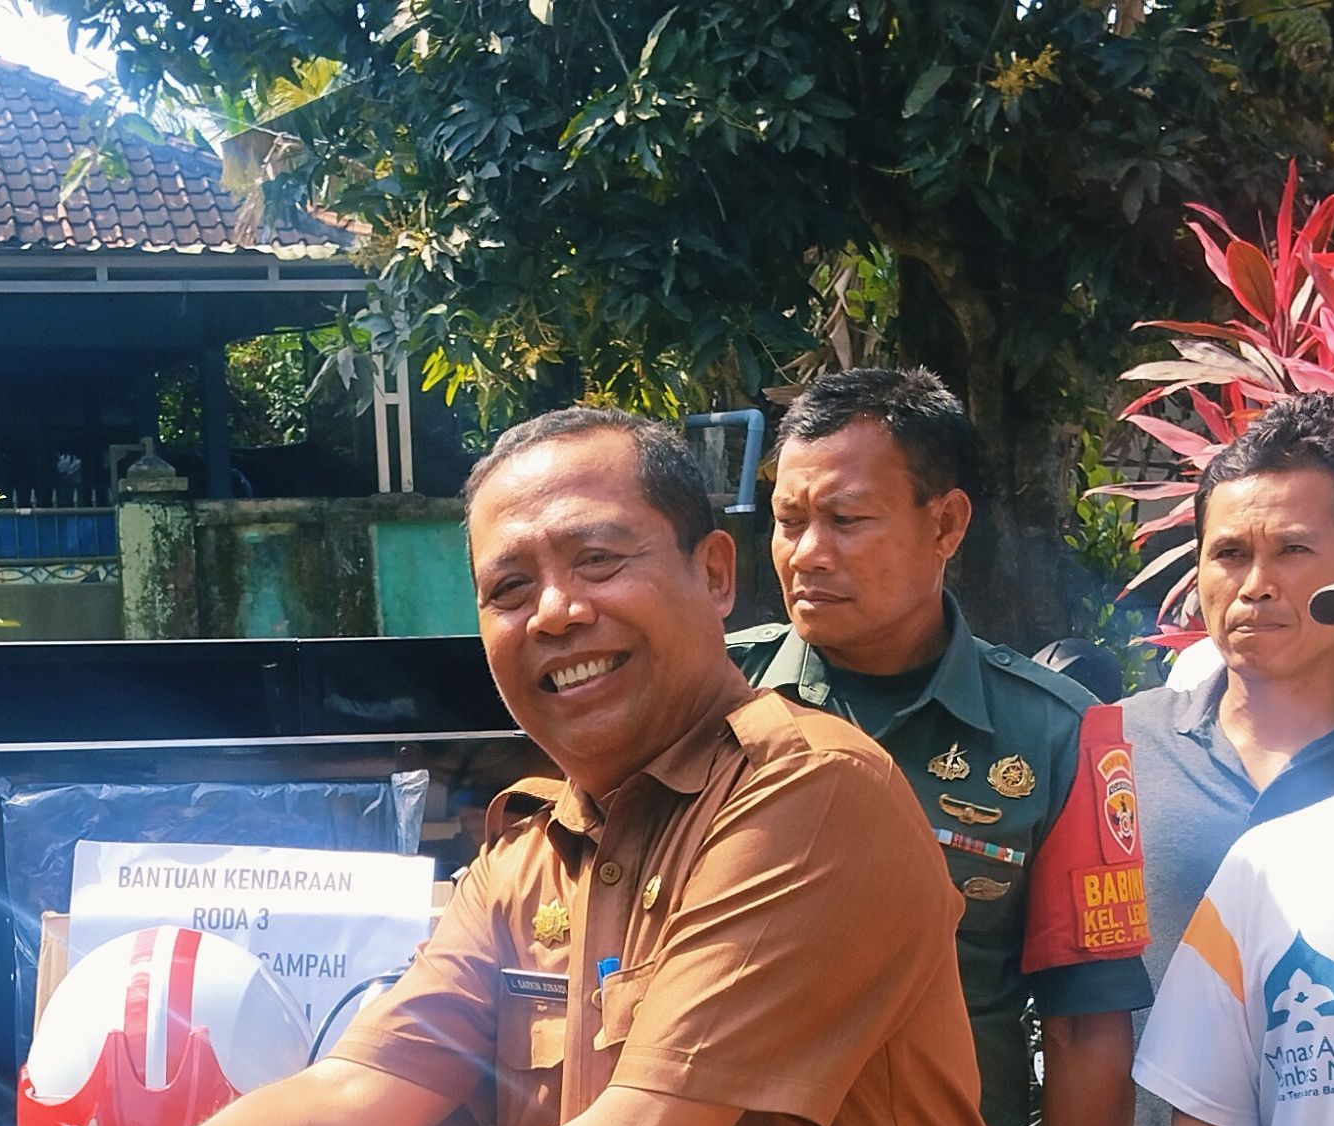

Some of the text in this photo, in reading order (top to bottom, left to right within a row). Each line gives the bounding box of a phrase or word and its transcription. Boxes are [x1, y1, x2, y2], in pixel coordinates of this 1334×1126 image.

[118, 866, 352, 892] BANTUAN KENDARAAN
[193, 906, 270, 931] RODA 3
